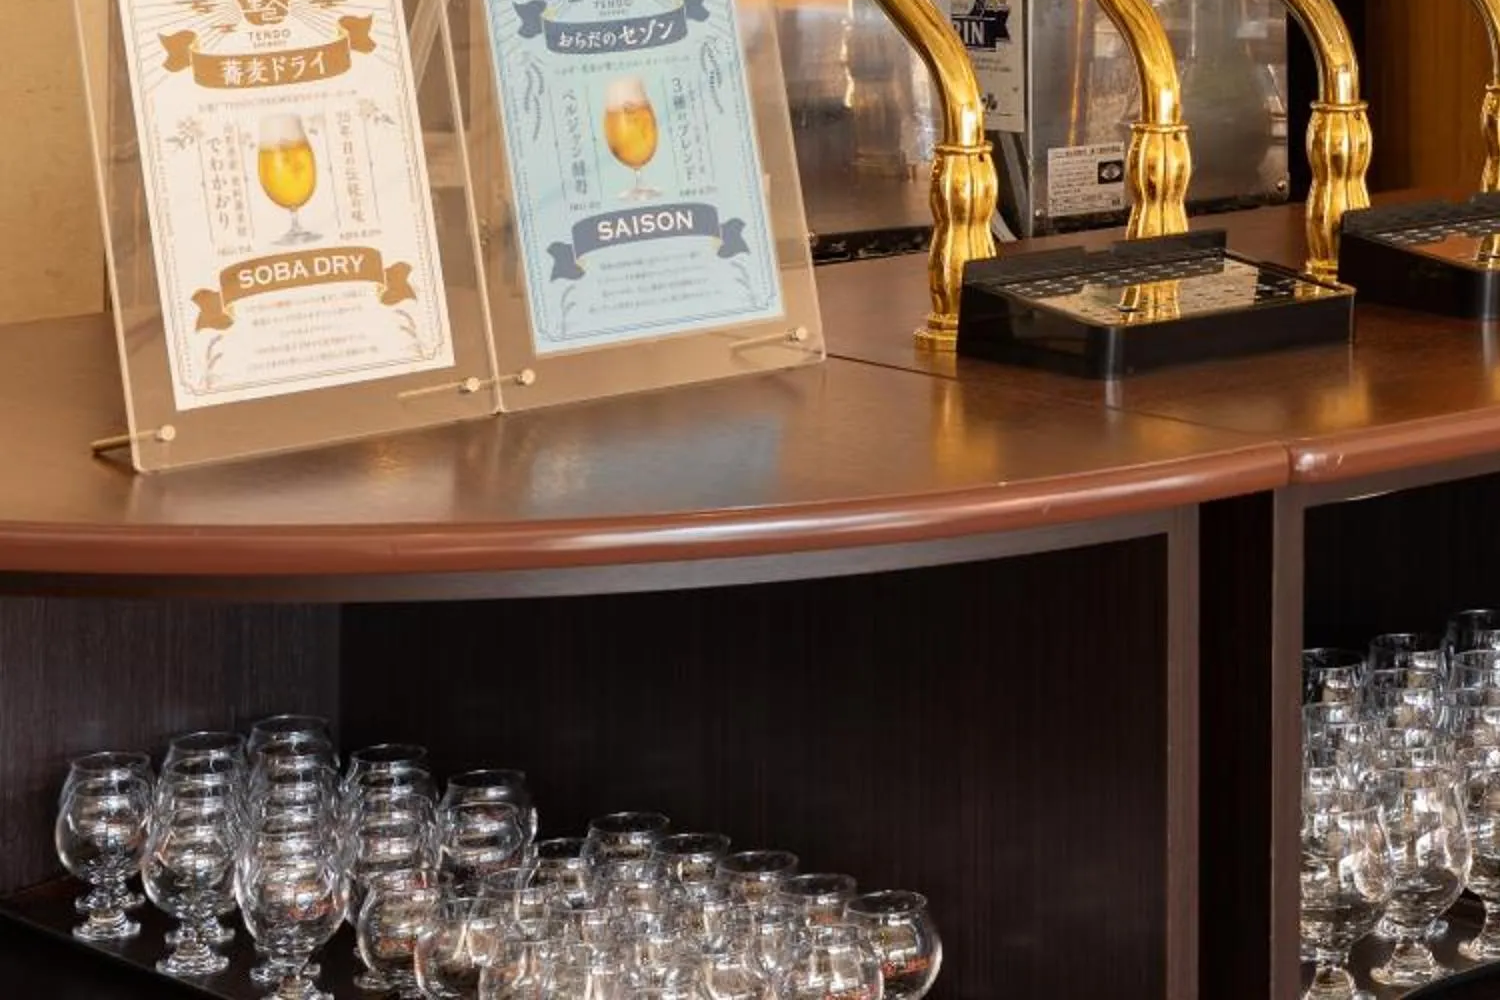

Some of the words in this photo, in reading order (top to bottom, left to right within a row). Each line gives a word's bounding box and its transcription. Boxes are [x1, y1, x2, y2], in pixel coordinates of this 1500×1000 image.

[557, 18, 675, 49] おらだのセゾン
[220, 50, 327, 86] 蕎麦ドライ
[597, 209, 694, 242] SAISON
[237, 259, 310, 289] SOBA
[314, 253, 366, 277] DRY
